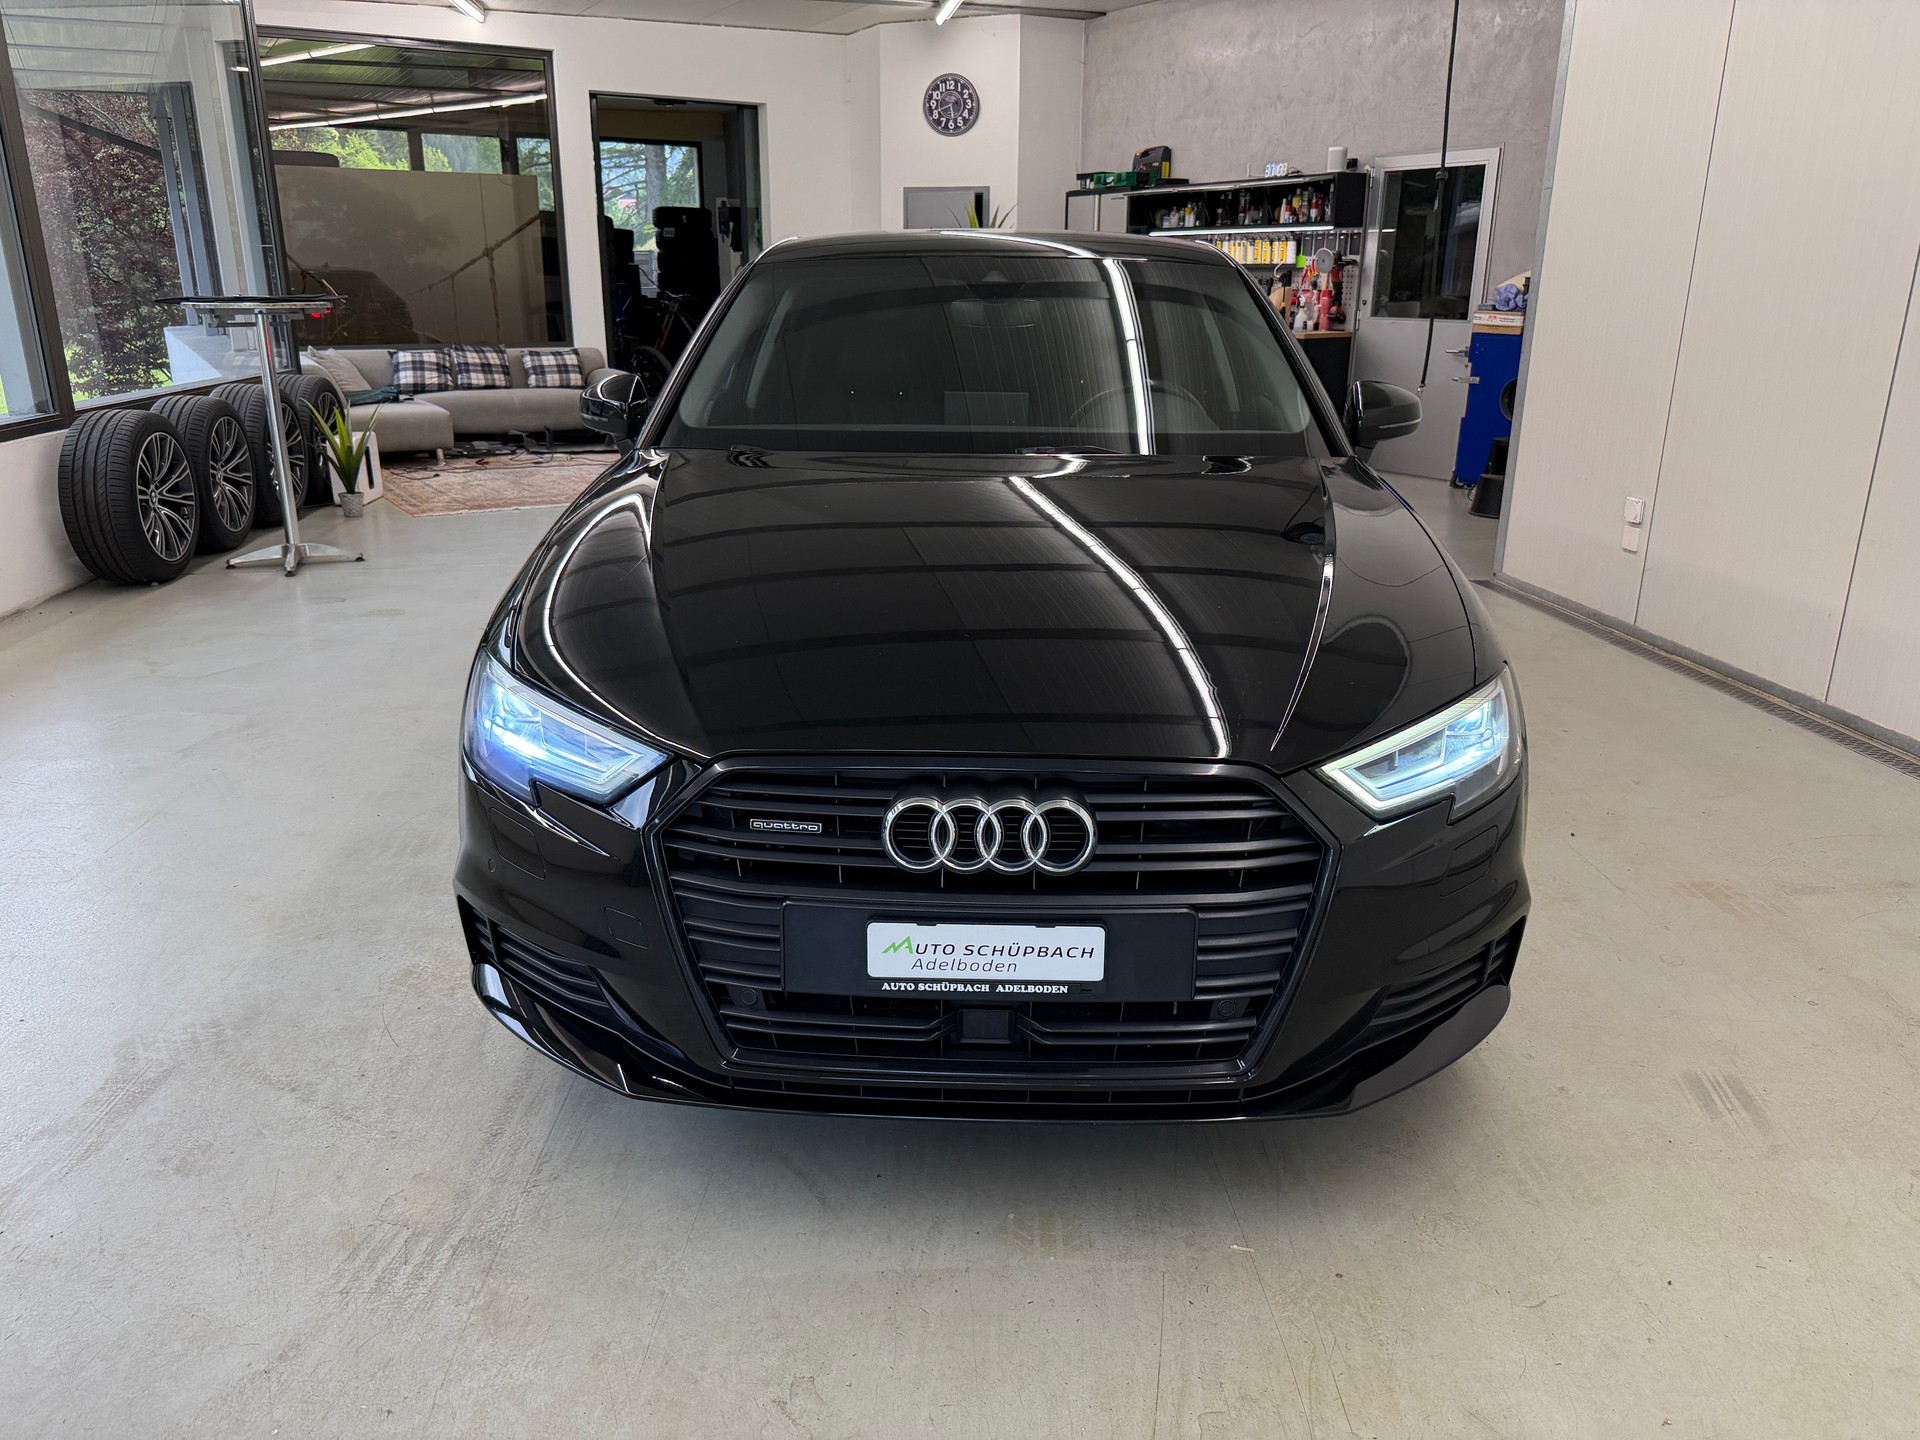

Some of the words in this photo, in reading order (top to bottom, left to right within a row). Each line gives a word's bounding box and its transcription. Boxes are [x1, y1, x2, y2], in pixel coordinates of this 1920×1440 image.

[939, 84, 946, 92] 11
[946, 80, 955, 90] 12
[932, 91, 940, 99] 10
[963, 90, 969, 98] 2
[930, 100, 936, 109] 9
[966, 100, 972, 108] 3
[932, 110, 939, 119] 8
[962, 109, 969, 119] 4
[940, 118, 946, 127] 7
[948, 120, 955, 129] 6
[957, 117, 963, 126] 5
[753, 821, 818, 831] quattro
[882, 936, 956, 956] AUTO
[963, 942, 1094, 958] SCHÜPBACH
[910, 958, 1017, 972] Adelboden
[882, 982, 916, 991] AUTO
[918, 982, 990, 992] SCHÜPBACH
[996, 984, 1068, 994] ADELBODEN
